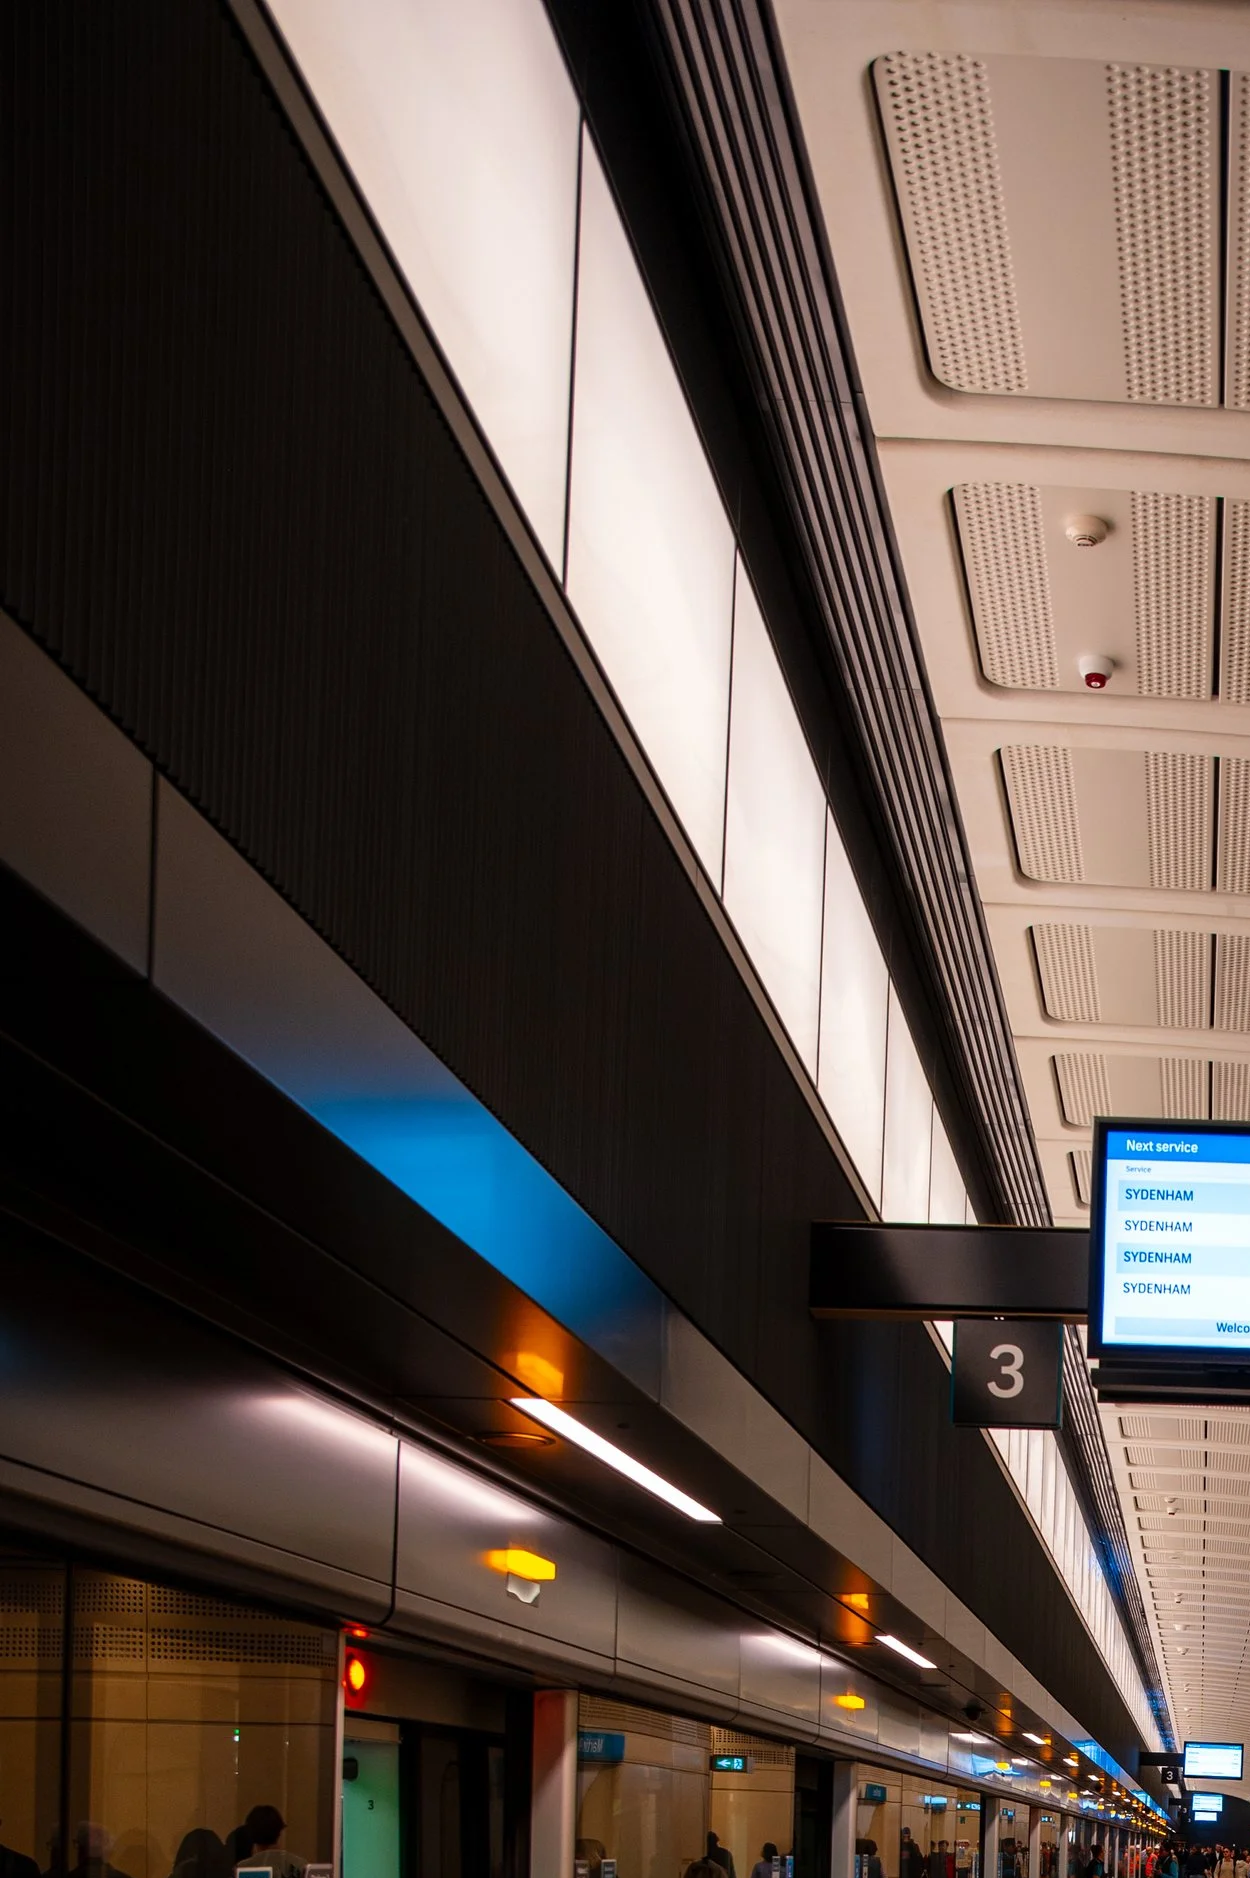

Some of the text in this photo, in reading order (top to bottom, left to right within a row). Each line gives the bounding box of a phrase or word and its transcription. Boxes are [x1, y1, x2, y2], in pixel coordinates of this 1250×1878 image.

[1126, 1139, 1199, 1153] Next service
[1125, 1165, 1152, 1174] Service
[1125, 1188, 1194, 1202] SYDENHAM
[1124, 1219, 1193, 1233] SYDENHAM
[1123, 1250, 1192, 1264] SYDENHAM
[1122, 1282, 1191, 1295] SYDENHAM
[986, 1343, 1025, 1399] 3
[1166, 1771, 1173, 1780] 3
[368, 1799, 374, 1810] 3
